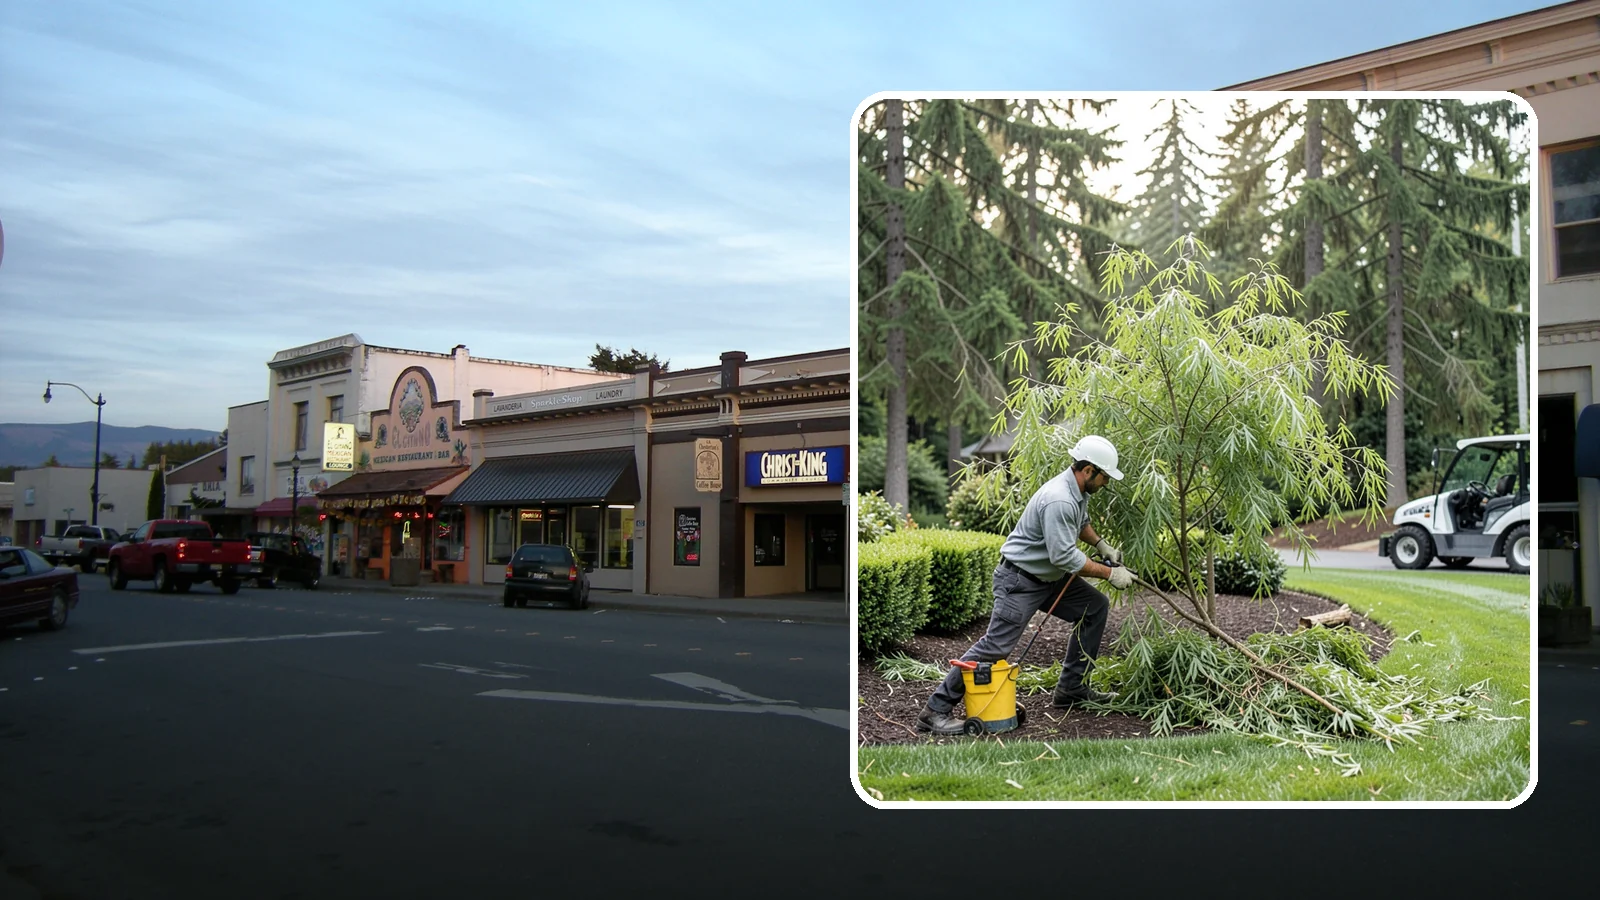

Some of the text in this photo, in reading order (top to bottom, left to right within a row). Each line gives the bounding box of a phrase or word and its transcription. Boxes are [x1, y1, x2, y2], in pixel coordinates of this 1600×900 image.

[531, 393, 583, 409] Sparkle Shop
[596, 389, 623, 400] LAUNDRY
[494, 402, 522, 412] LAVANDERIA
[374, 450, 450, 464] MEXICAN RESTAURANT BAR
[761, 450, 828, 478] CHRIST KING
